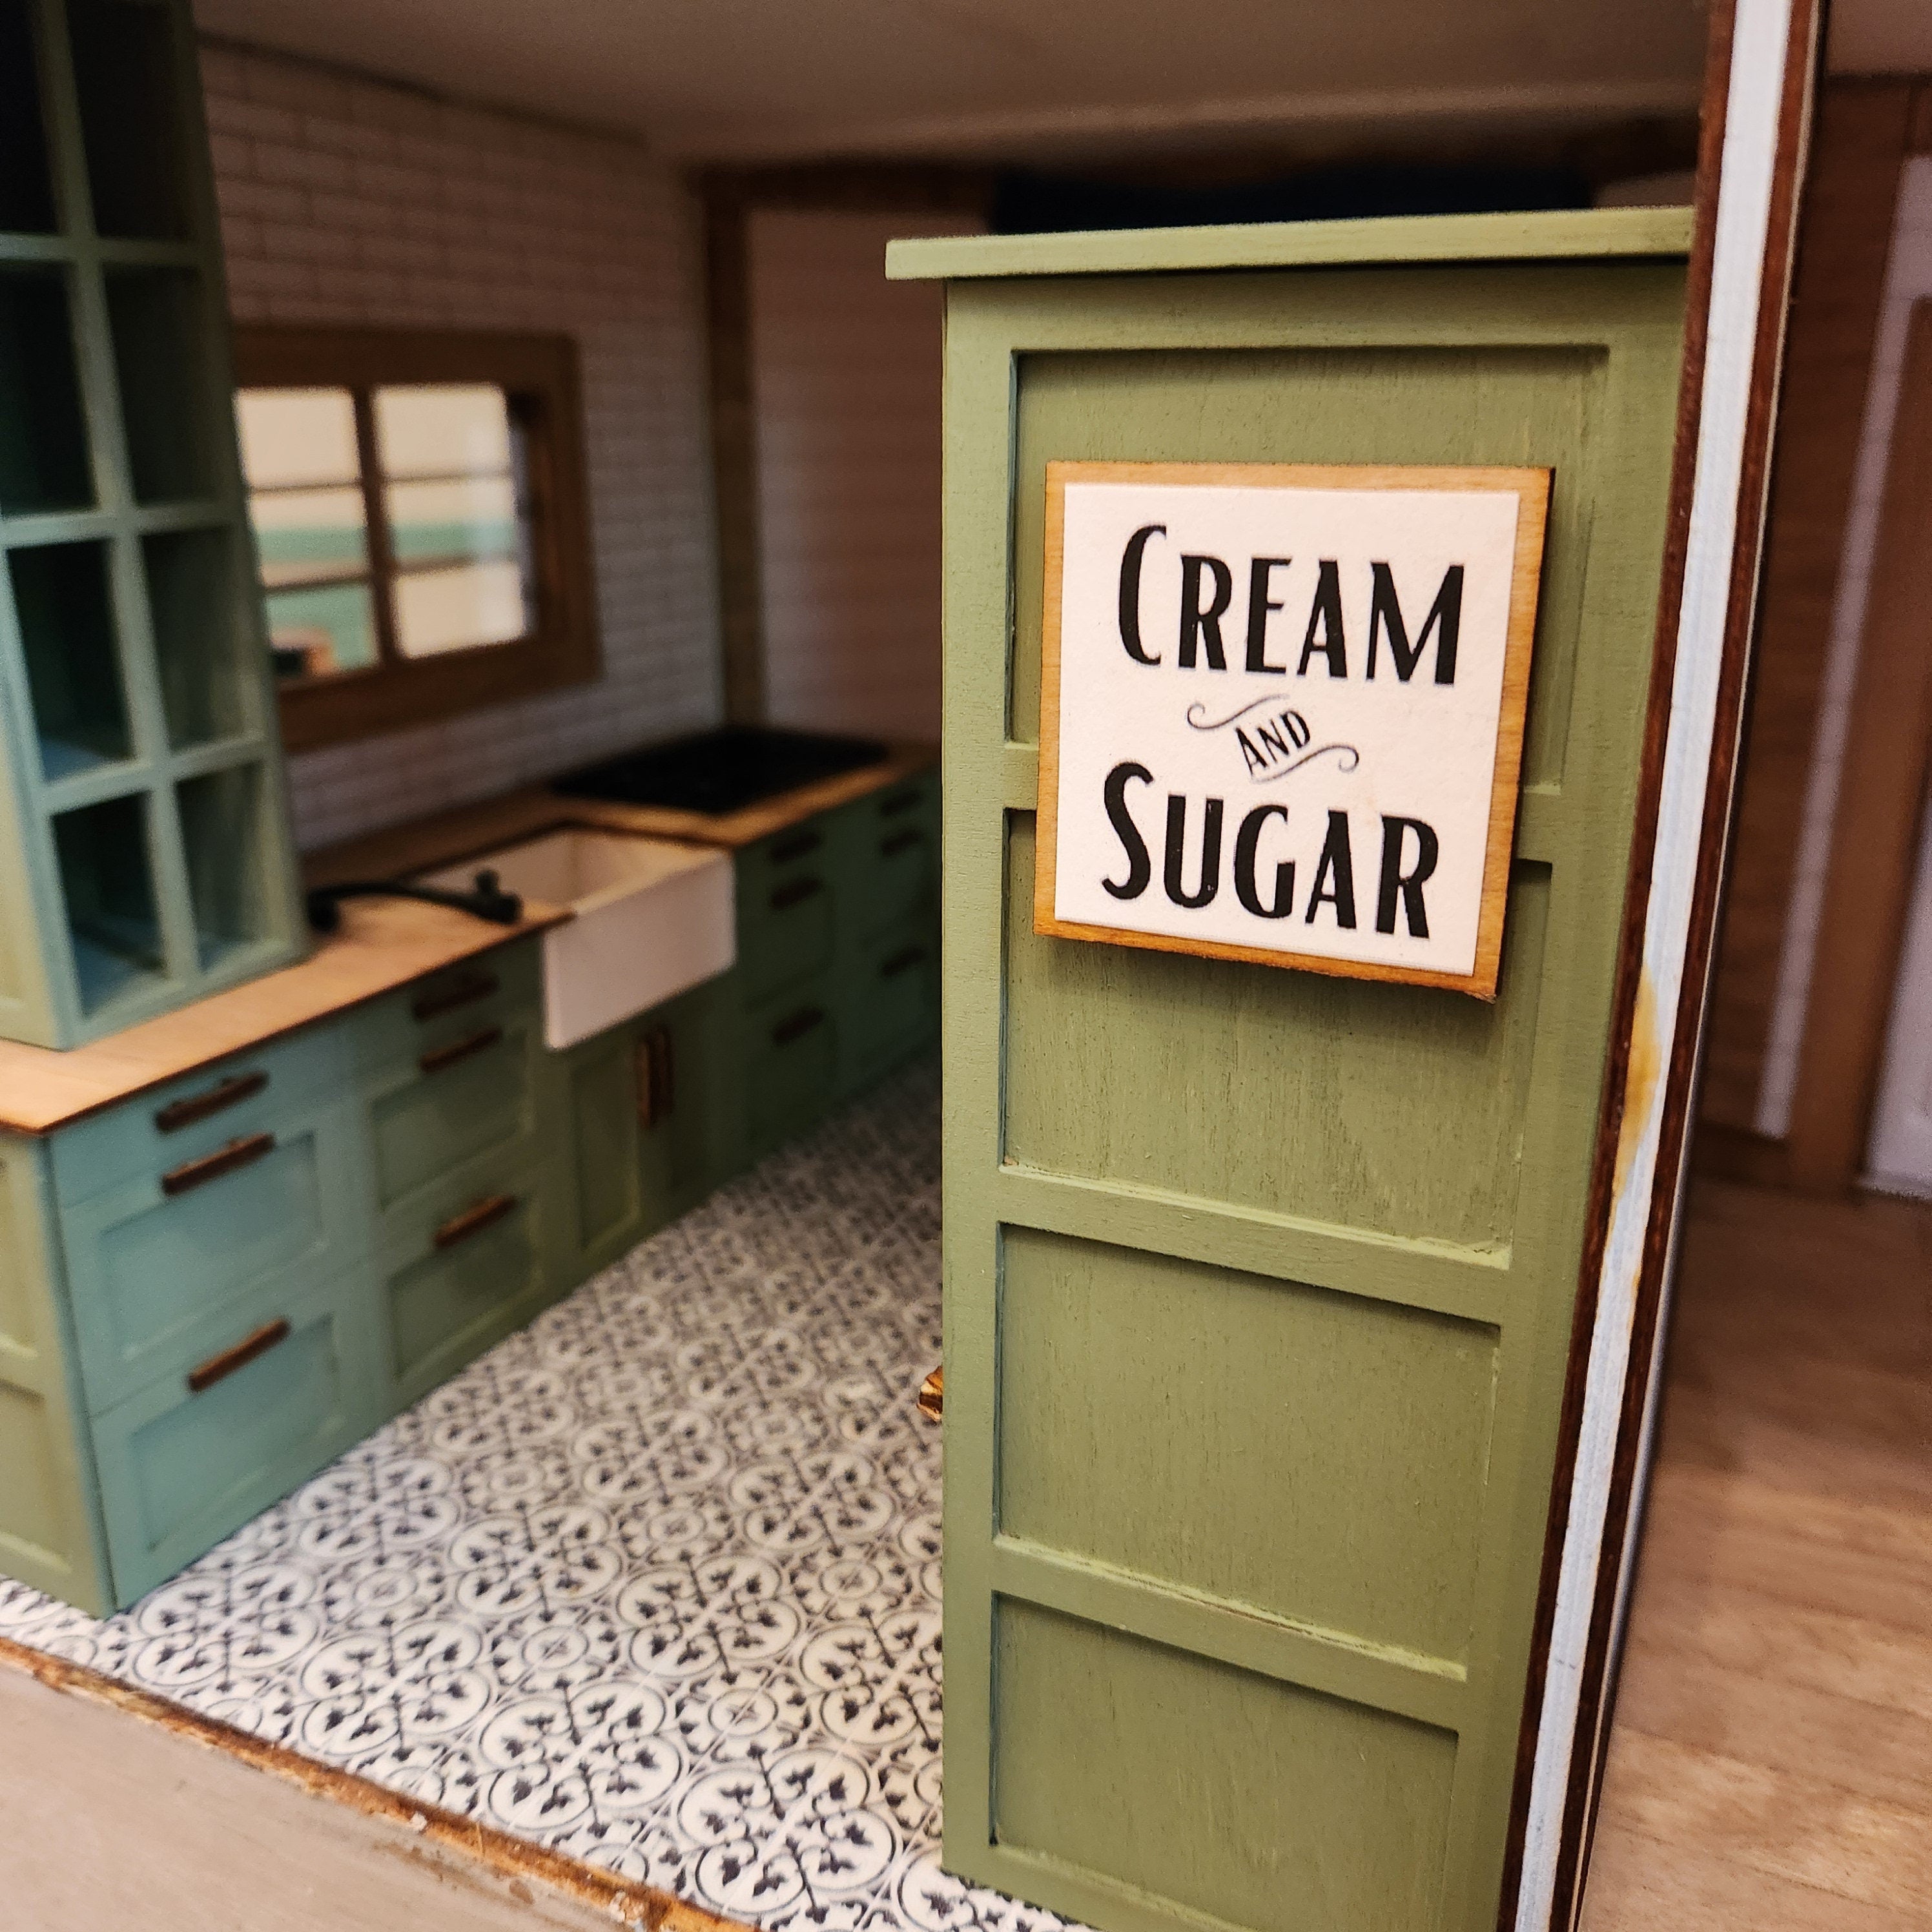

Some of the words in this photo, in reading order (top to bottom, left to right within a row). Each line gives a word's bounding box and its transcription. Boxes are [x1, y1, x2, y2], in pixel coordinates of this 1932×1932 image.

[1118, 524, 1464, 686] CREAM
[1235, 710, 1311, 776] AND
[1101, 761, 1439, 940] SUGAR
